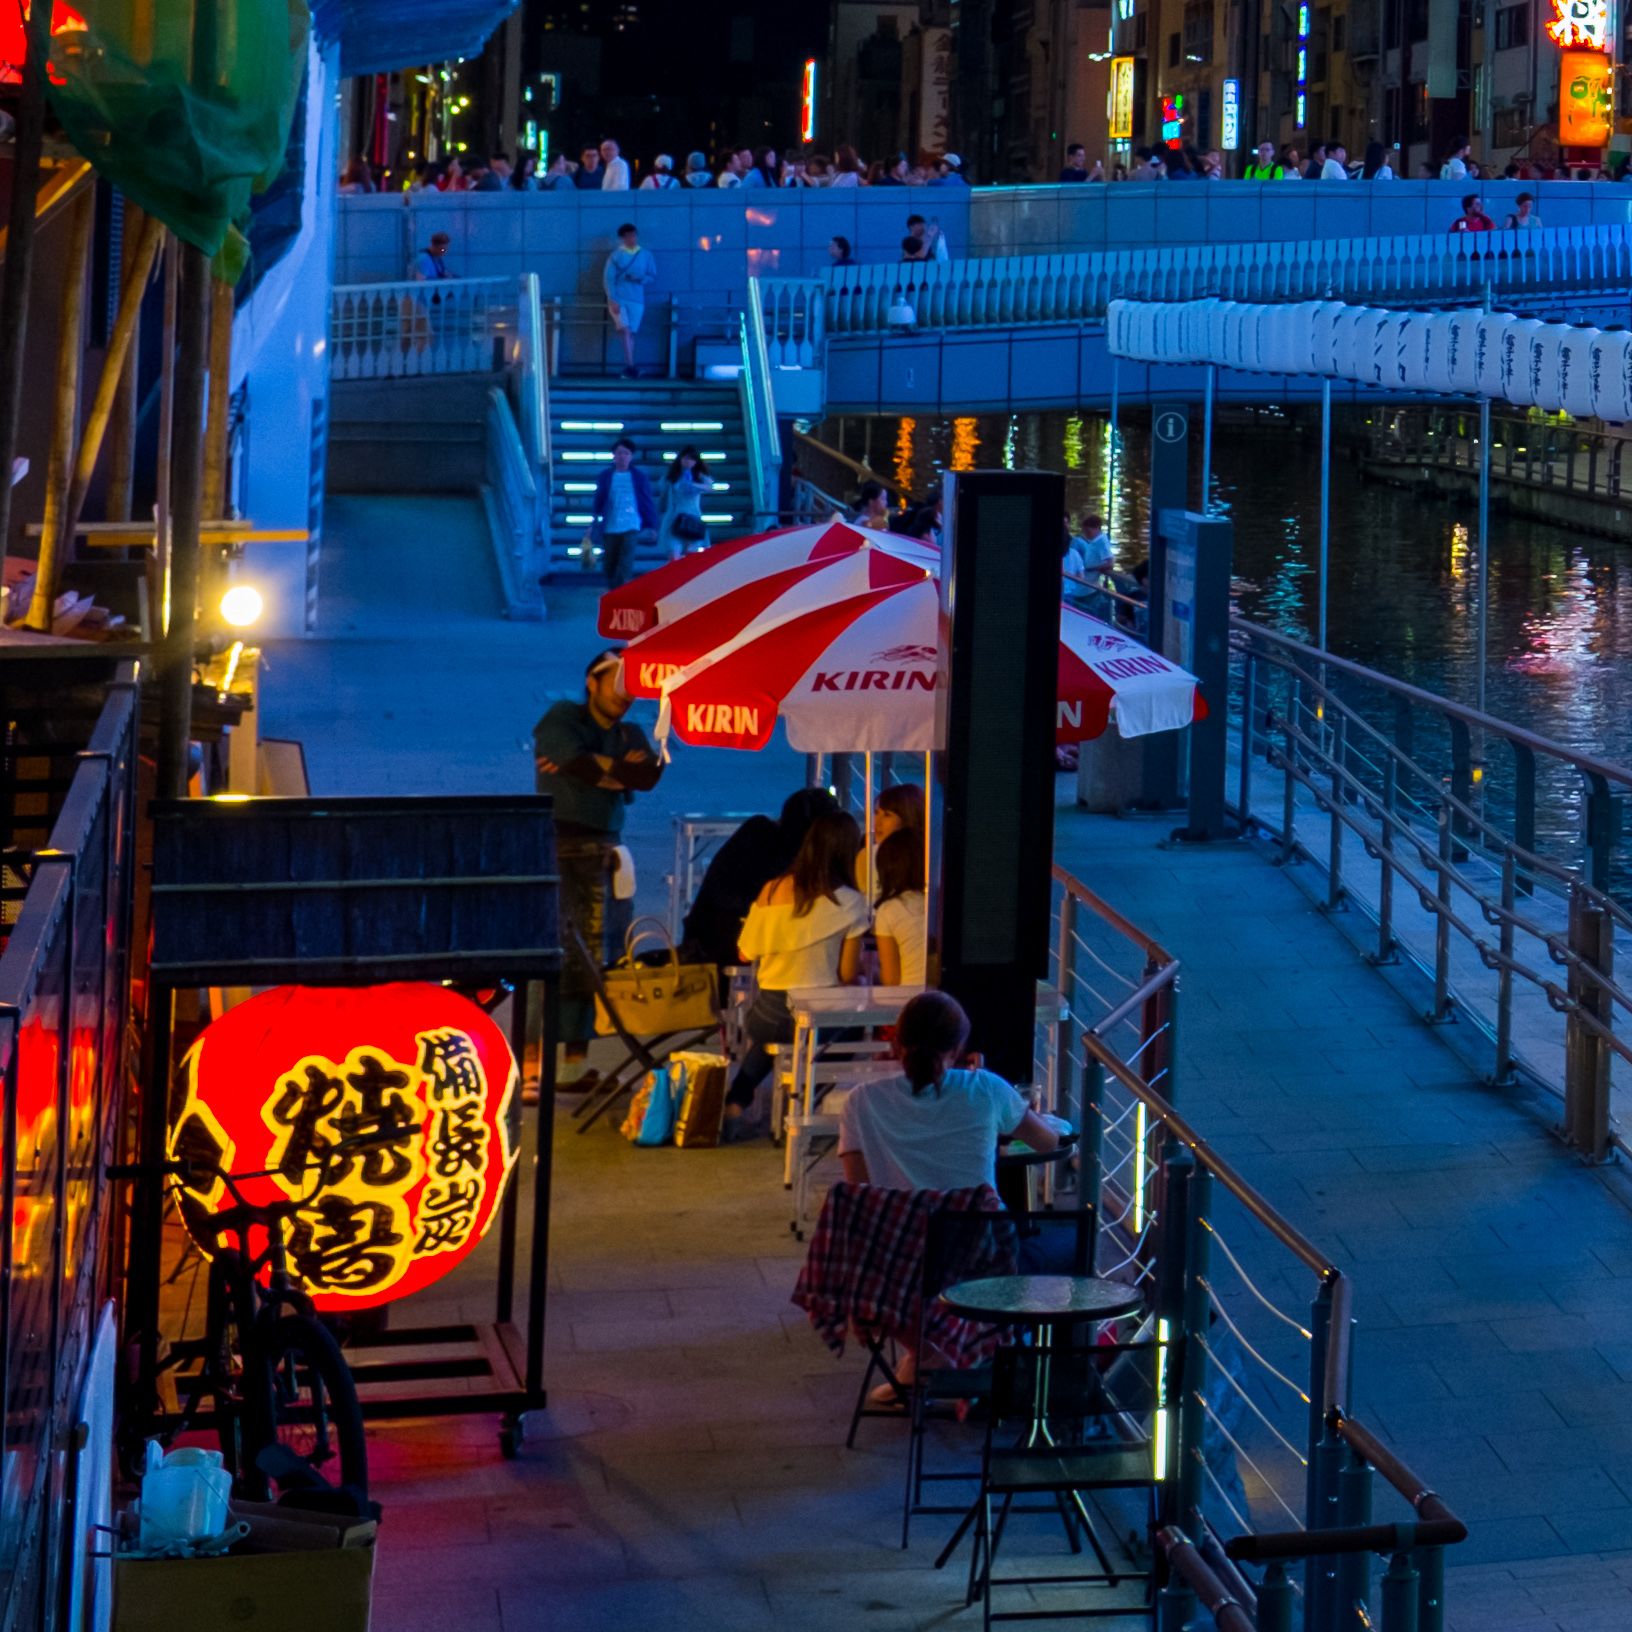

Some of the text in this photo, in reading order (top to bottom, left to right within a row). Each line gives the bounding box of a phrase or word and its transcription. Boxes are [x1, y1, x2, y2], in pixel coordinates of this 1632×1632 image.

[811, 669, 949, 693] KIRIN
[1093, 656, 1173, 682] KIRIN
[687, 704, 759, 736] KIRIN
[418, 1029, 488, 1254] 備長炭
[268, 1056, 421, 1291] 焼鳥
